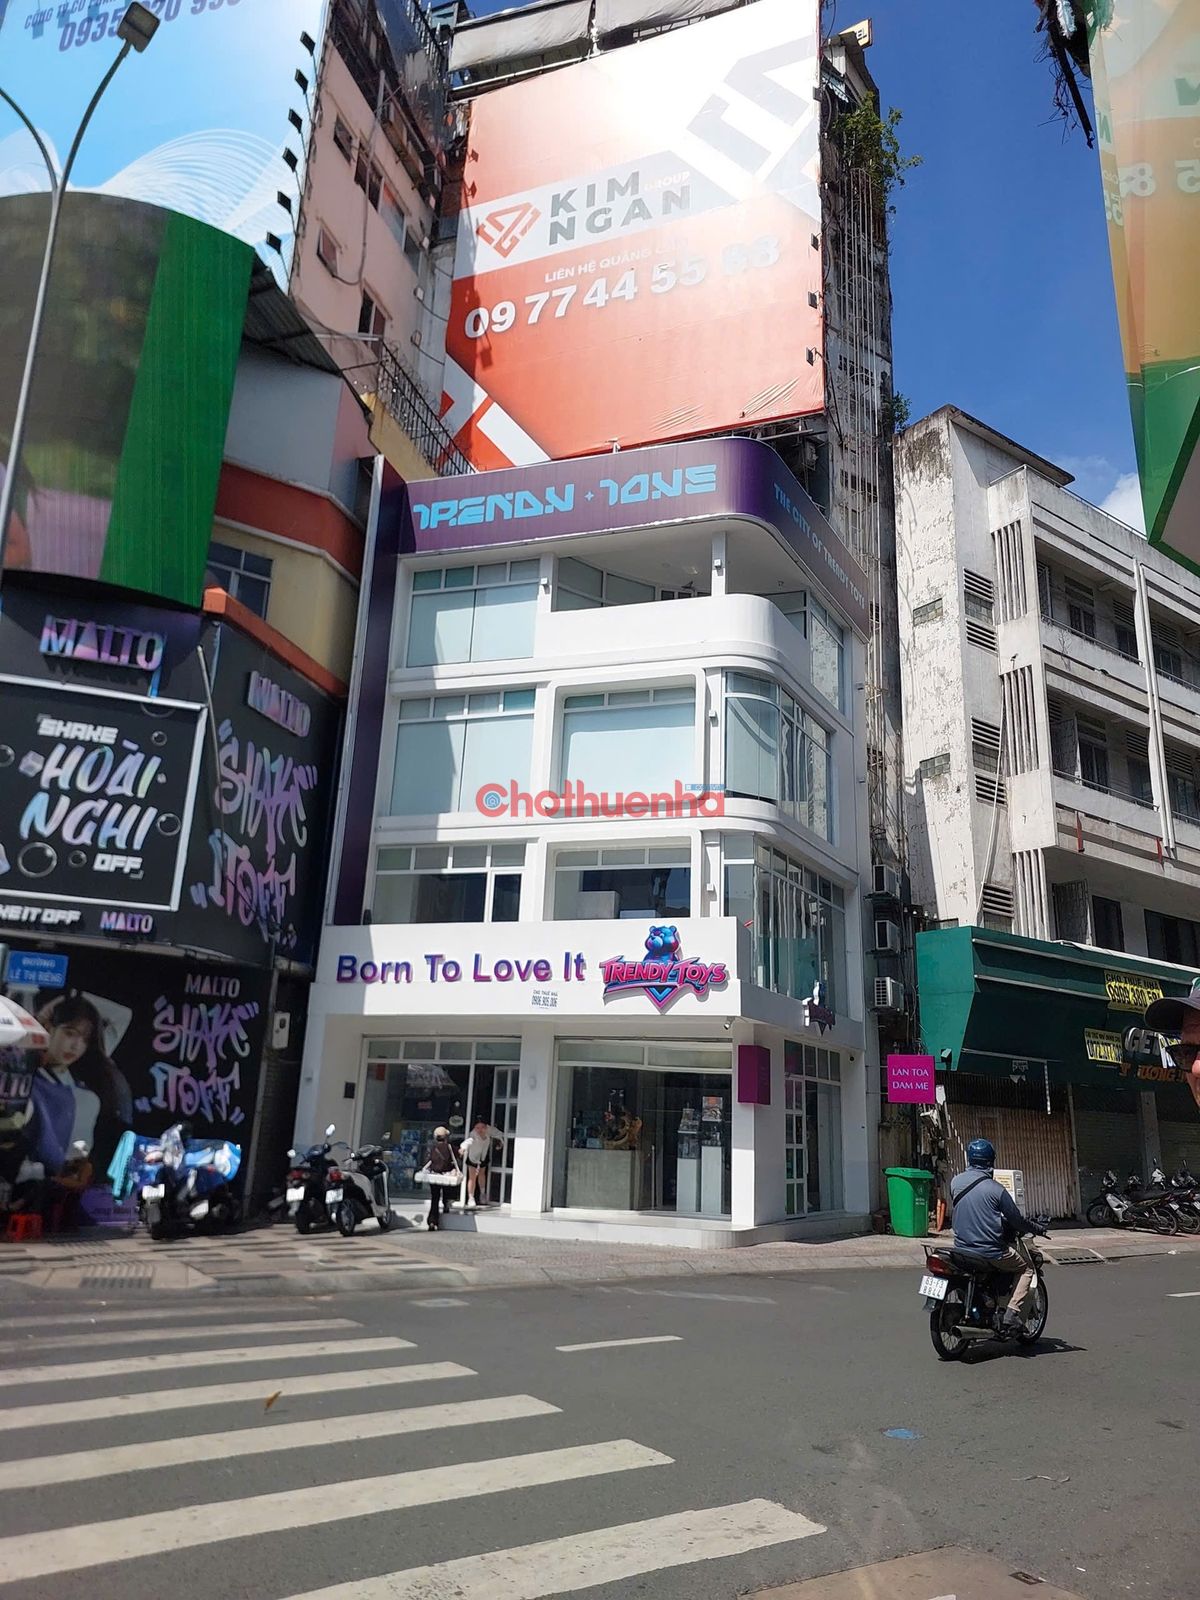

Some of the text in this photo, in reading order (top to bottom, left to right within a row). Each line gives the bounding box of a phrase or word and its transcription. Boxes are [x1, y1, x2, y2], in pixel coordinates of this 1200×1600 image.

[550, 171, 640, 218] KIM
[549, 185, 691, 246] NGAN
[544, 266, 575, 283] LIÊN
[578, 260, 596, 276] HỆ
[464, 301, 516, 339] 09
[525, 286, 577, 325] 77
[582, 268, 638, 309] 44
[650, 256, 707, 295] 55
[773, 482, 791, 513] THE
[792, 506, 811, 539] CITY
[812, 532, 823, 553] OF
[823, 546, 849, 588] TRENDY
[40, 615, 165, 671] MALTO
[37, 717, 118, 745] SHAKE
[20, 791, 158, 851] NGHI
[93, 853, 143, 874] OFF
[101, 911, 154, 933] MALTO
[336, 951, 586, 983] Born To Love It
[599, 955, 727, 986] TRENDY TOYS
[185, 973, 241, 996] MALTO
[892, 1067, 910, 1076] LAN
